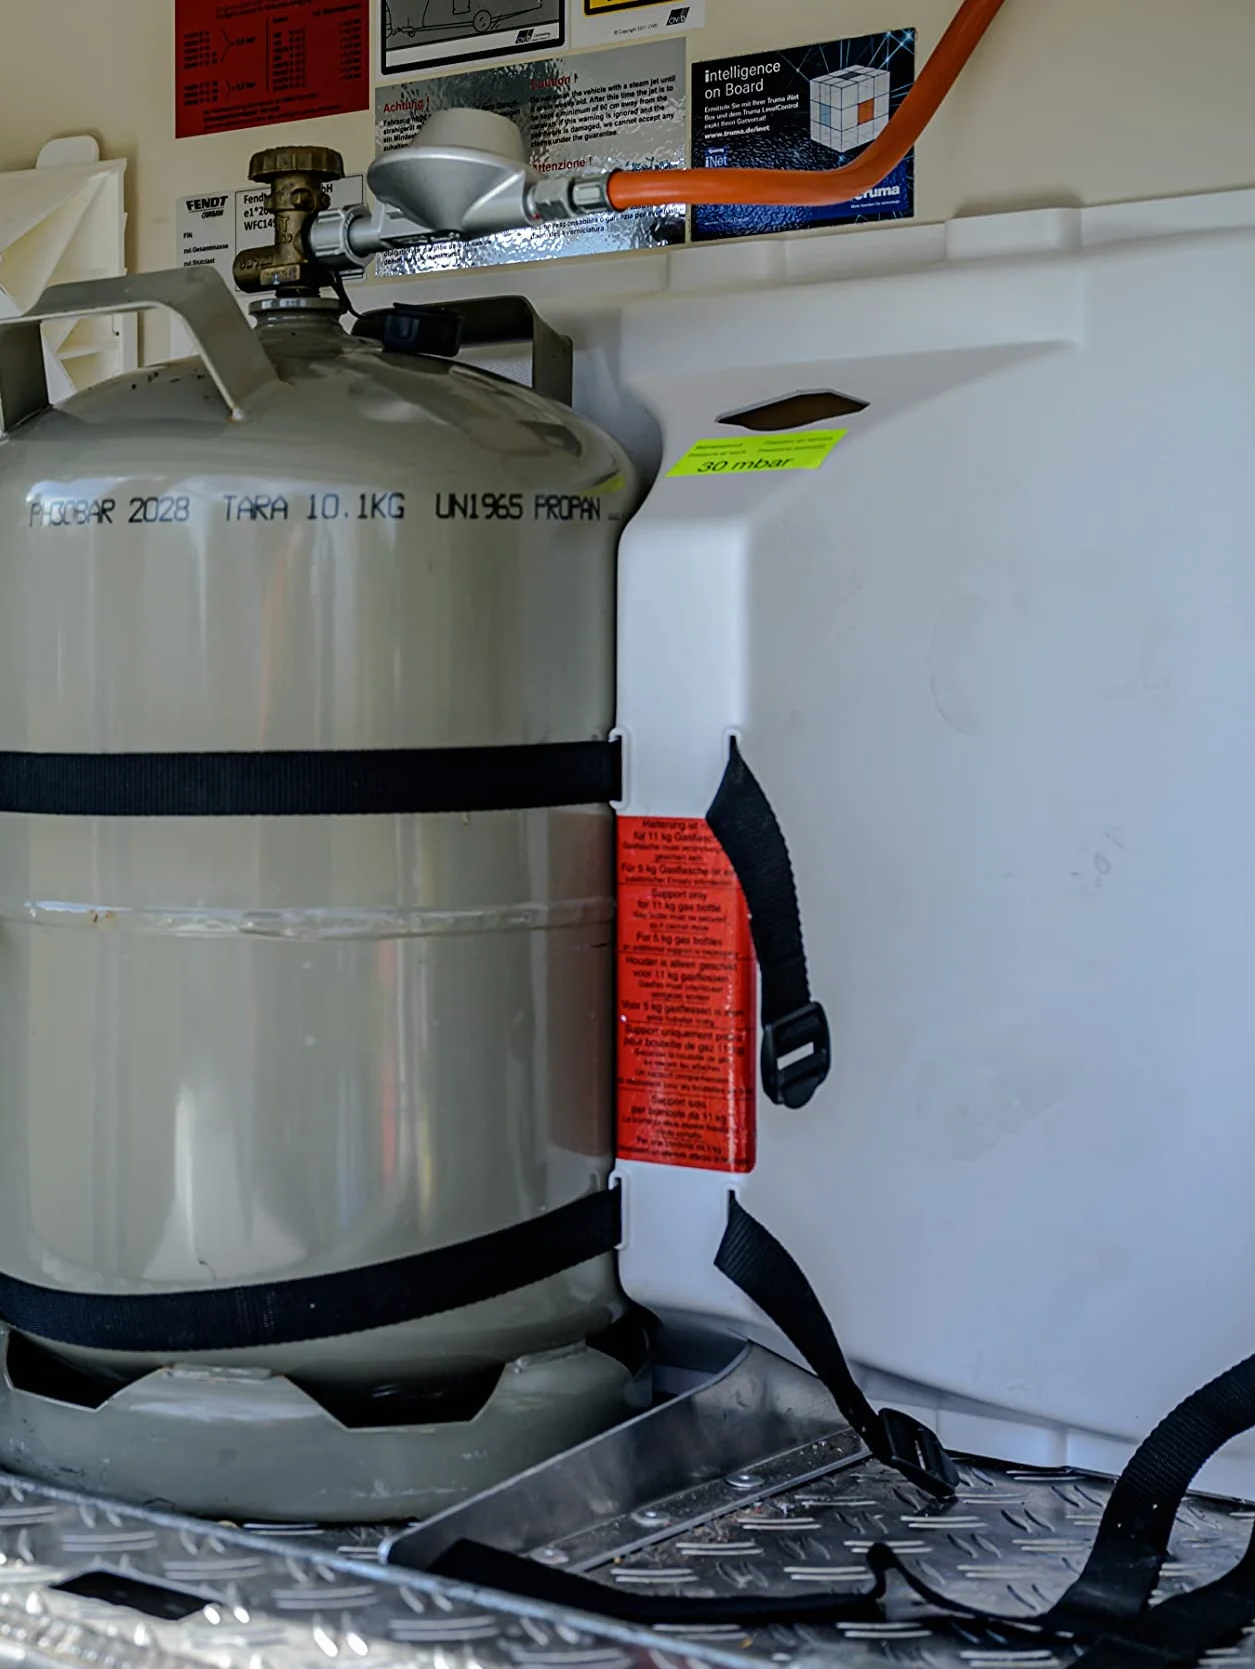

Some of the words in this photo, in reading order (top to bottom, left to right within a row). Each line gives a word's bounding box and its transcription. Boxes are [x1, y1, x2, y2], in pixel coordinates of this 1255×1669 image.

[705, 62, 781, 83] intelligence
[583, 86, 606, 95] vehicle
[608, 83, 621, 92] with
[629, 80, 649, 88] steam
[650, 78, 659, 87] jet
[660, 75, 676, 83] until
[649, 87, 657, 96] jet
[704, 88, 721, 99] on
[725, 78, 764, 96] Board
[384, 99, 424, 112] Achtung
[560, 108, 590, 116] minimum
[729, 110, 742, 118] dem
[743, 108, 761, 116] Truma
[762, 102, 799, 113] LevelControl
[613, 107, 638, 119] ignored
[614, 117, 637, 126] cannot
[638, 114, 661, 123] accept
[662, 112, 675, 120] any
[704, 125, 770, 139] www.truma.de/inet
[531, 159, 586, 173] Attenzione
[705, 156, 728, 168] iNet
[186, 195, 228, 211] FENDT
[697, 460, 728, 473] 30
[731, 457, 794, 471] mbar
[128, 497, 190, 524] 2028
[224, 495, 288, 522] TARA
[307, 492, 405, 520] 10.1KG
[436, 492, 523, 520] UN1965
[534, 494, 601, 521] PROPAN
[661, 832, 672, 843] kg
[646, 864, 657, 875] kg
[659, 864, 708, 875] Gasflasche
[651, 888, 687, 899] Support
[665, 901, 676, 912] kg
[678, 903, 694, 912] gas
[696, 903, 721, 912] bottle
[636, 932, 651, 941] For
[661, 934, 673, 945] kg
[675, 936, 691, 945] gas
[693, 935, 723, 946] bottles
[632, 970, 652, 978] voor
[667, 971, 679, 981] kg
